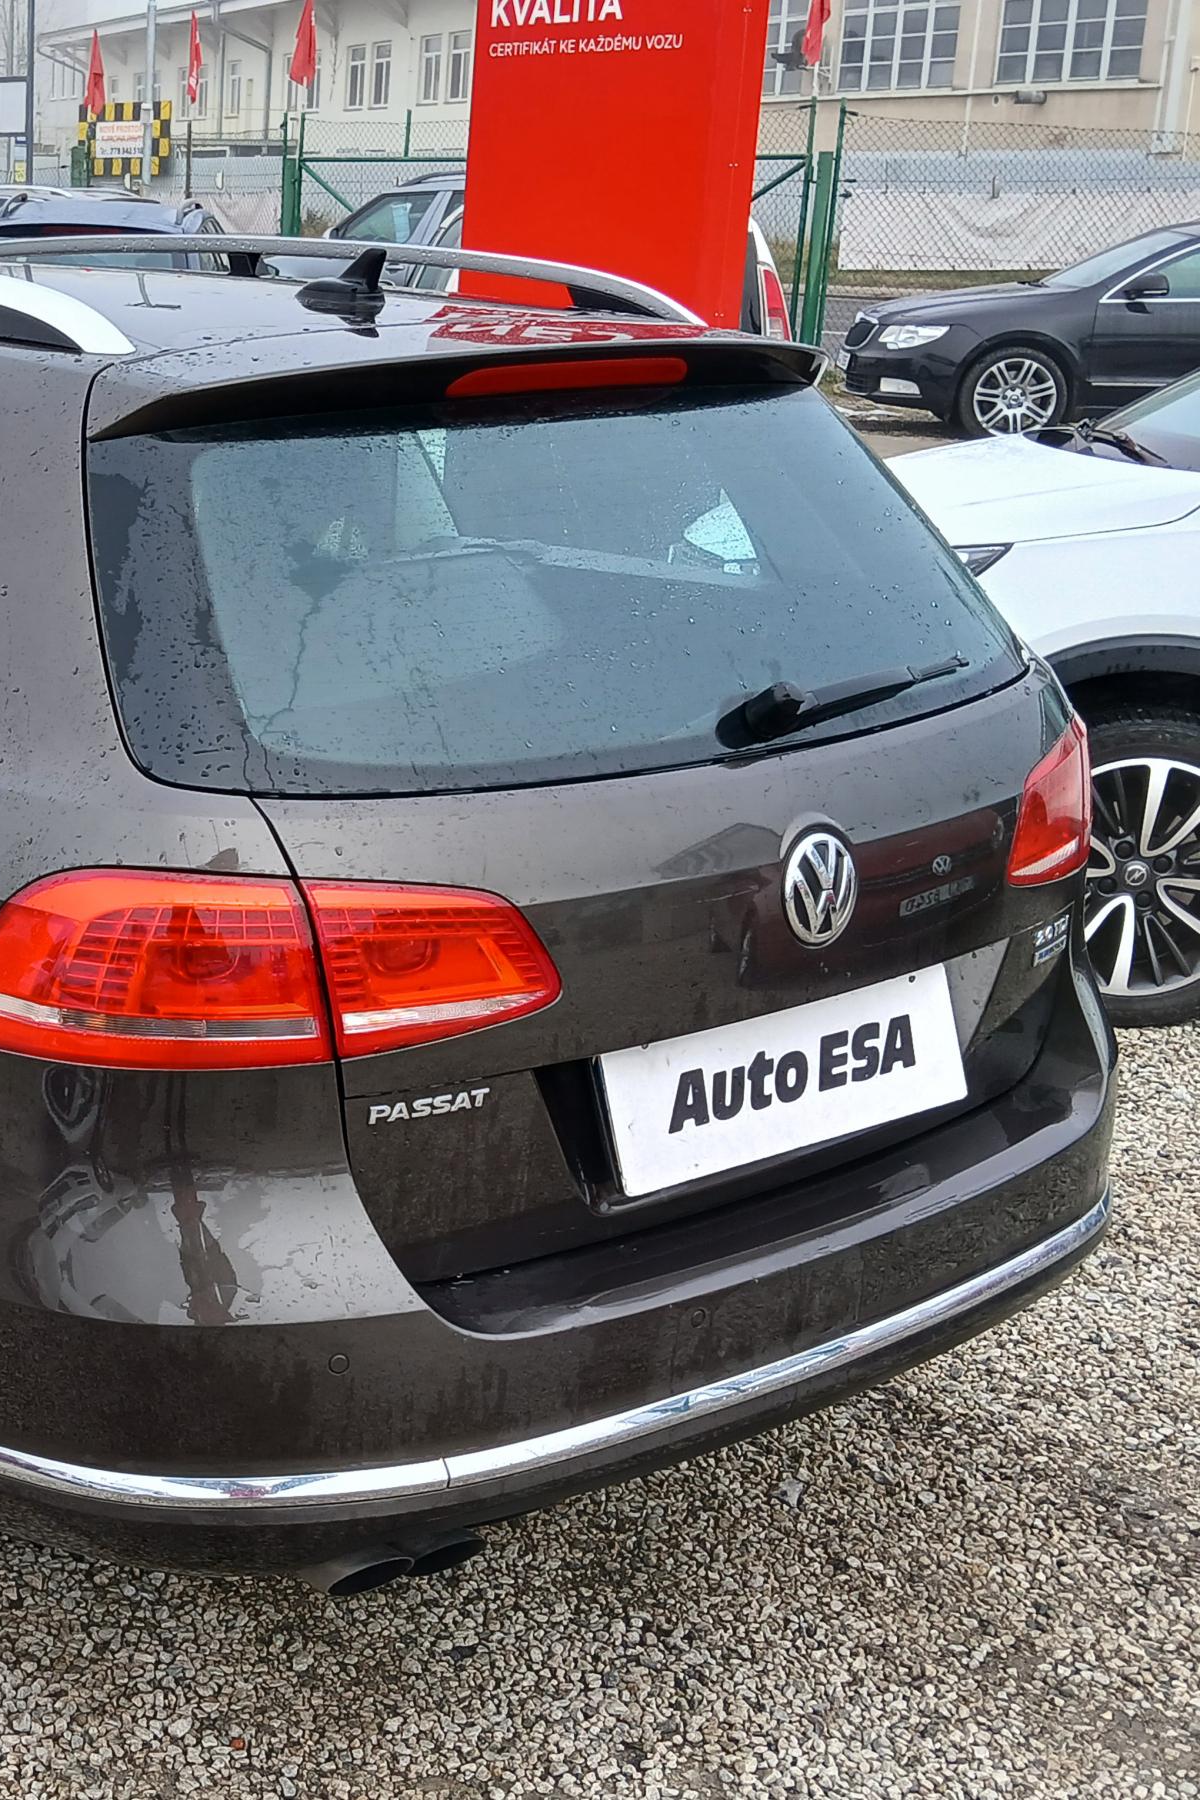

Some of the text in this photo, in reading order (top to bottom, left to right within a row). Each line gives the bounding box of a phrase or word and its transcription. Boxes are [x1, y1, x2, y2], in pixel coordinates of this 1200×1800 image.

[491, 0, 624, 28] KVALITA
[489, 33, 684, 57] CERTIFIKÁT KE KAŽDÉMU VOZU
[668, 1014, 916, 1134] Auto ESA
[368, 1087, 490, 1125] PASSAT
